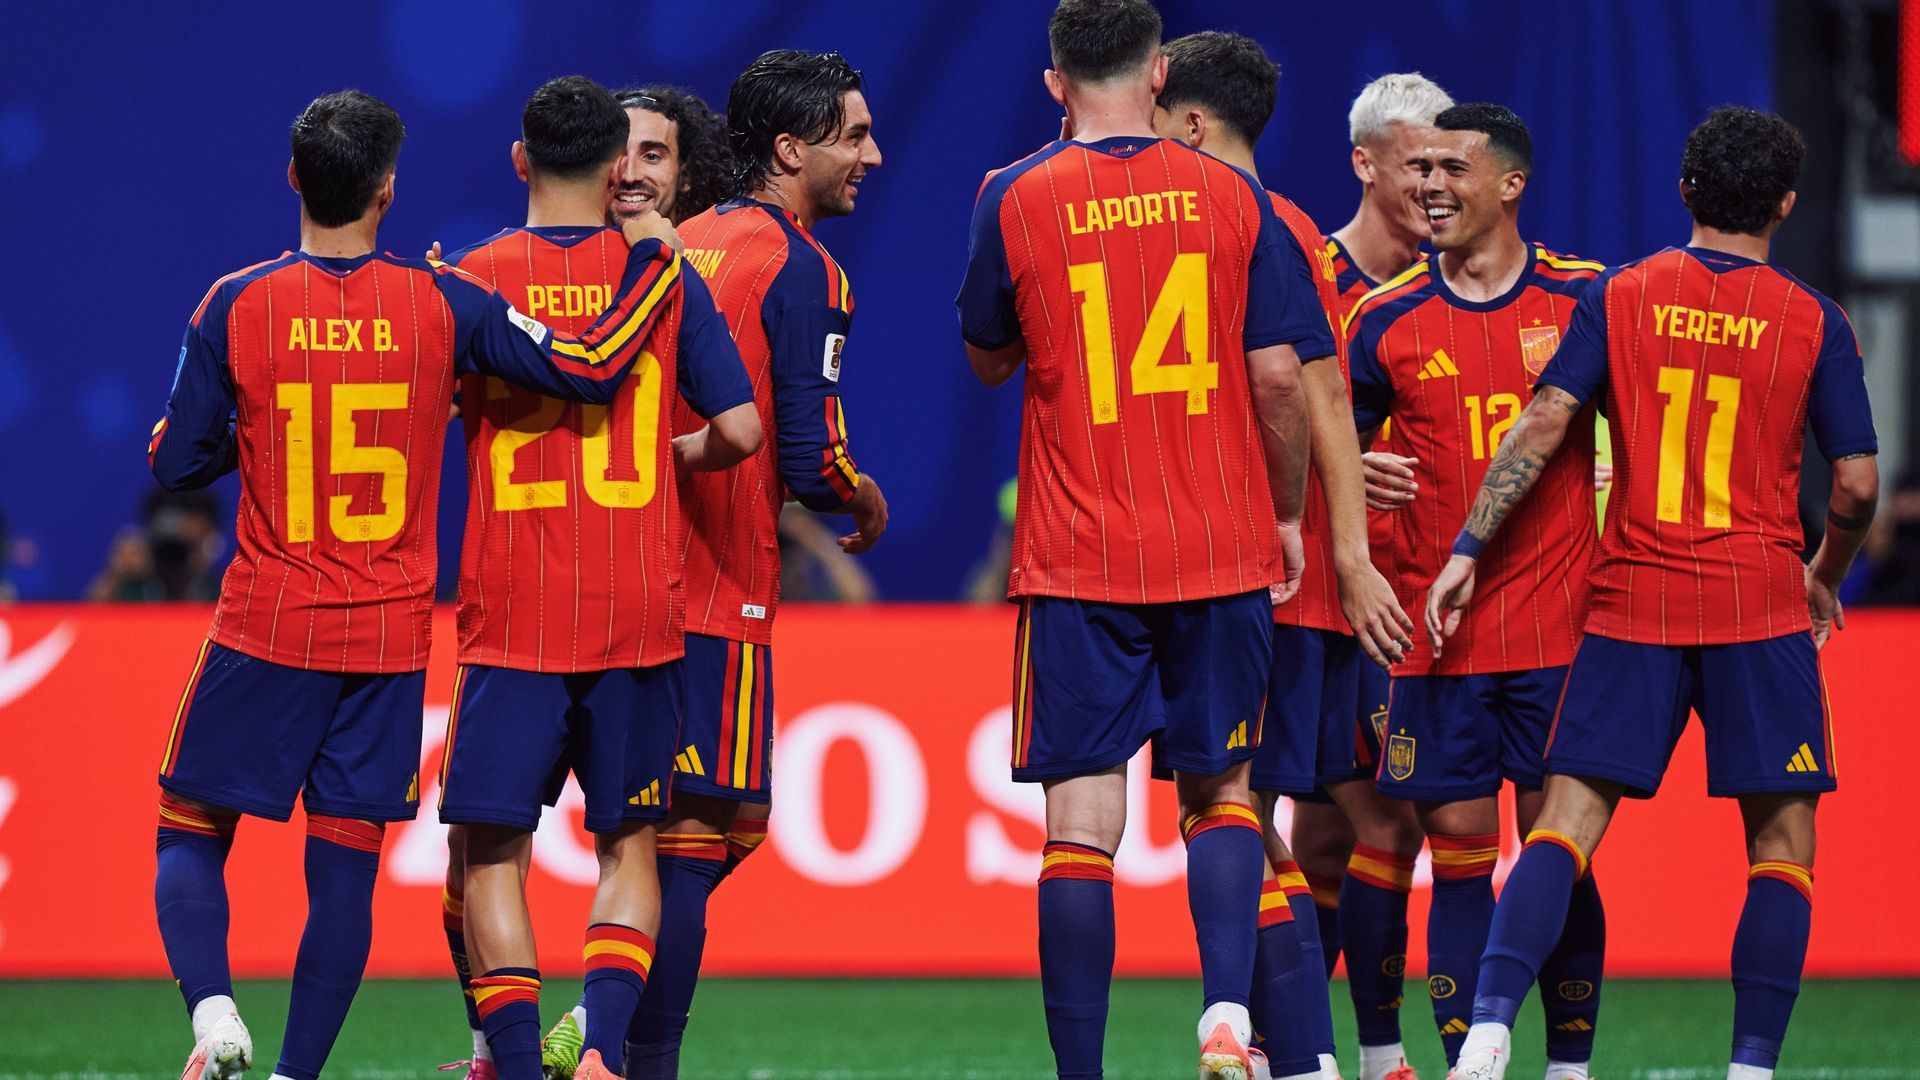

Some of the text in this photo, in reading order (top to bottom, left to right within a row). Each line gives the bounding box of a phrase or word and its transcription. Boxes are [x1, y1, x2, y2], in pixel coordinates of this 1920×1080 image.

[1065, 191, 1200, 235] LAPORTE
[288, 317, 400, 351] ALEX B.
[526, 284, 612, 317] PEDRI
[1652, 304, 1769, 350] YEREMY
[1068, 252, 1219, 425] 14
[487, 348, 662, 512] 20
[1464, 392, 1521, 460] 12
[1656, 366, 1742, 528] 11
[276, 382, 410, 543] 15
